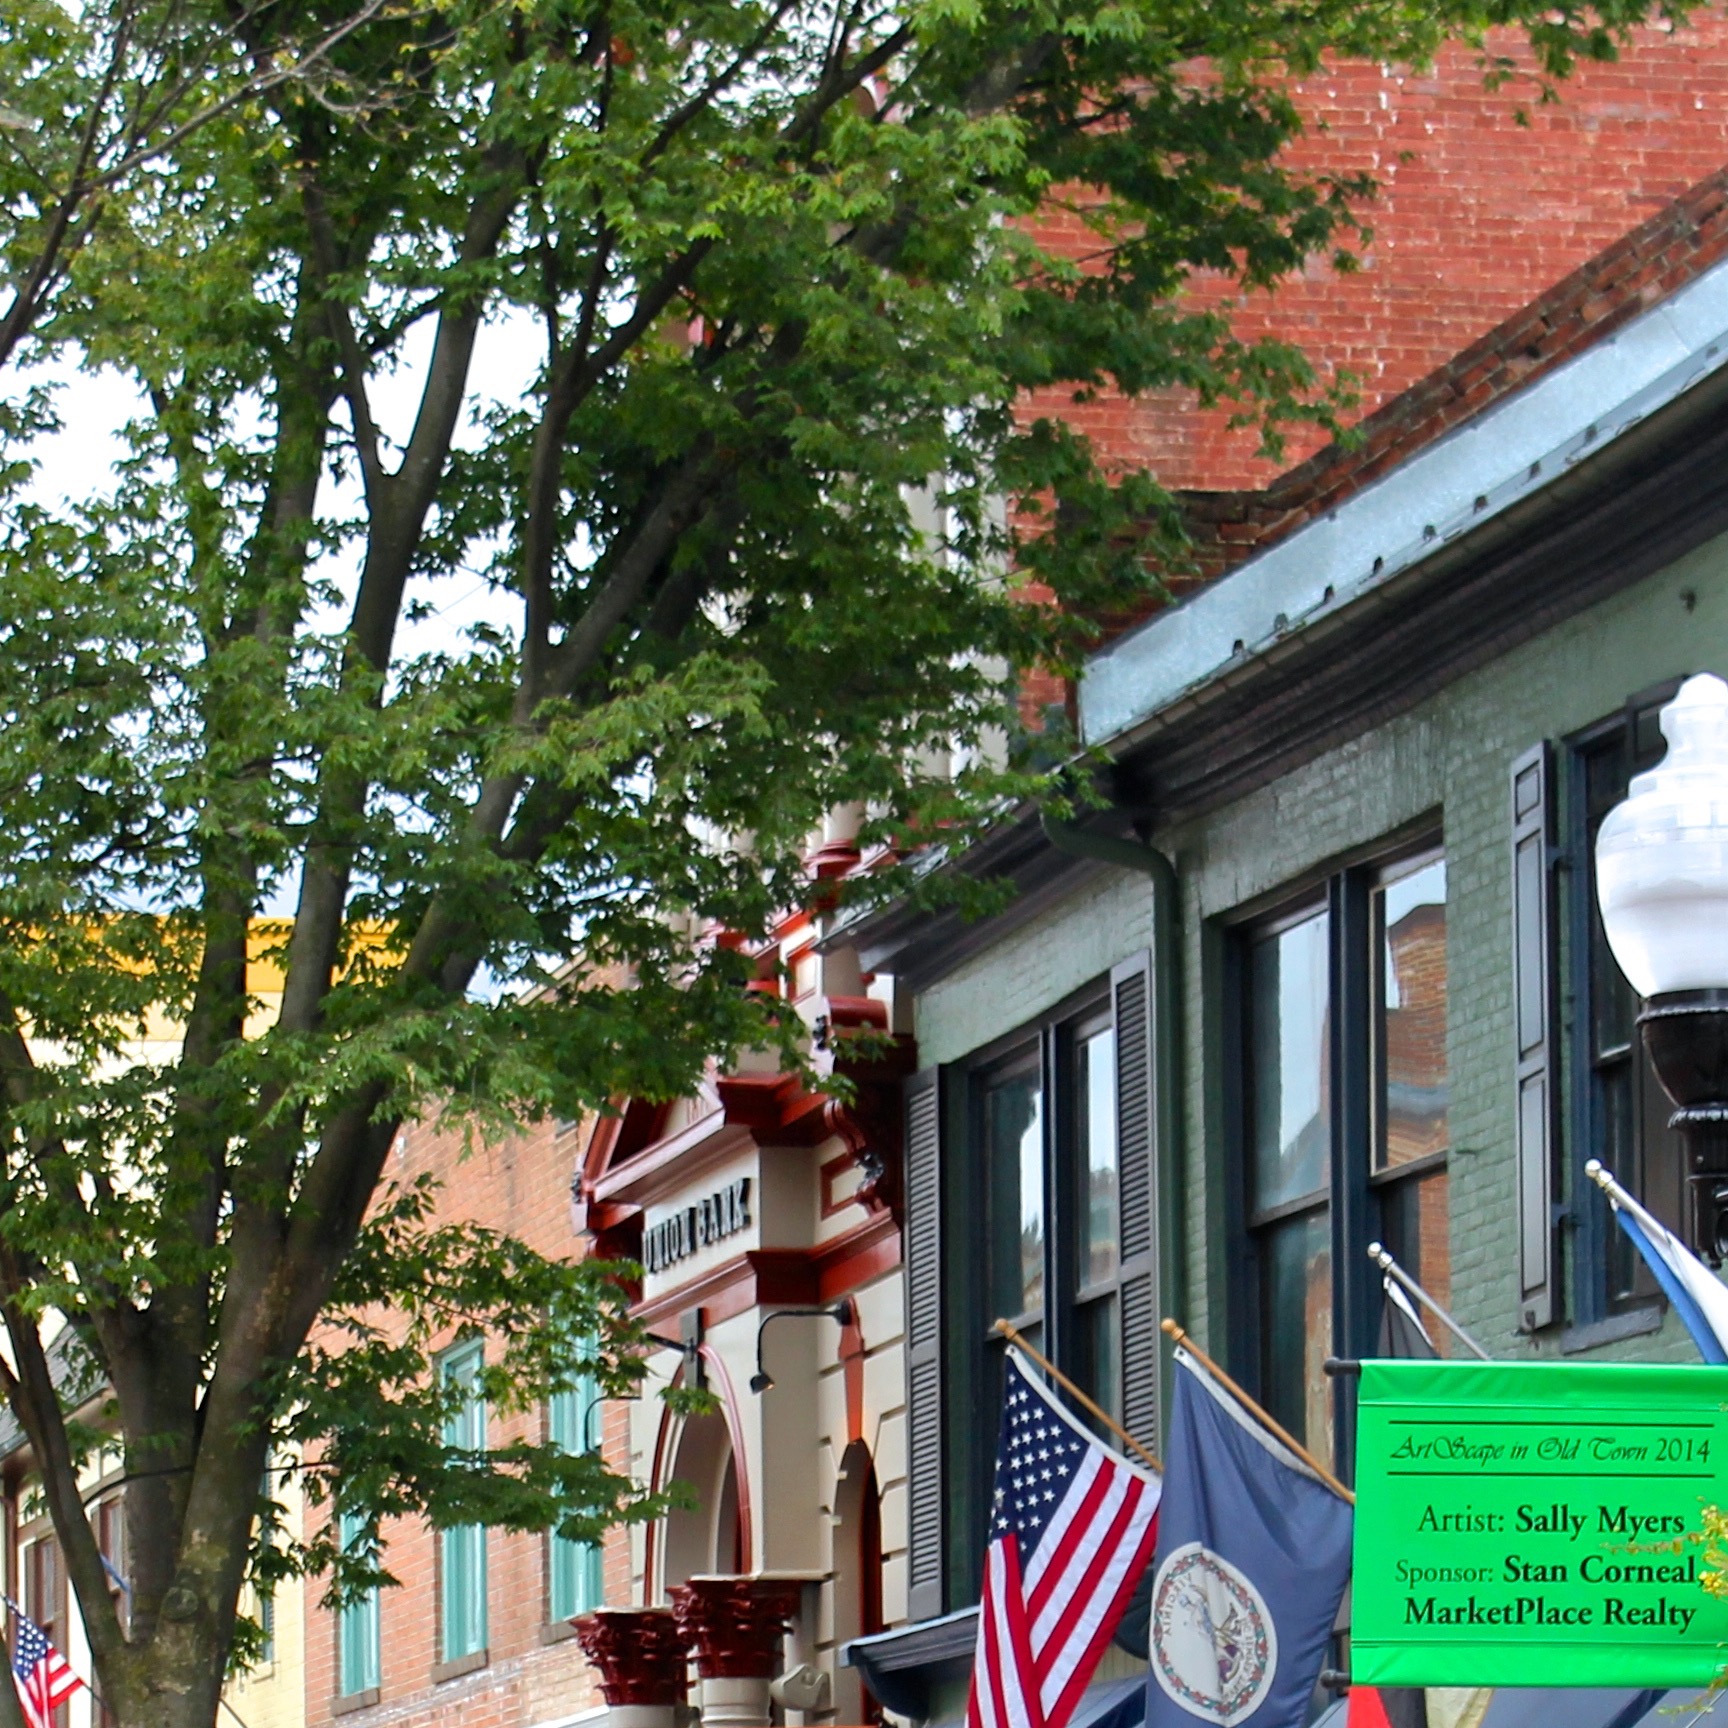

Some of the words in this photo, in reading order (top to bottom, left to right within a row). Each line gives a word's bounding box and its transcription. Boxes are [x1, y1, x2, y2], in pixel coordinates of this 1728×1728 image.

[643, 1207, 697, 1275] UNION
[697, 1178, 752, 1247] BANK
[1389, 1435, 1504, 1468] ArtScape
[1510, 1437, 1528, 1459] in
[1536, 1436, 1580, 1460] Old
[1587, 1437, 1647, 1463] Town
[1655, 1438, 1711, 1464] 2014
[1418, 1504, 1505, 1533] Artist:
[1515, 1504, 1586, 1542] Sally
[1597, 1505, 1685, 1542] Myers
[1395, 1559, 1494, 1592] Sponsor:
[1503, 1555, 1568, 1583] Stan
[1403, 1597, 1593, 1626] MarketPlace
[1602, 1598, 1697, 1634] Realty
